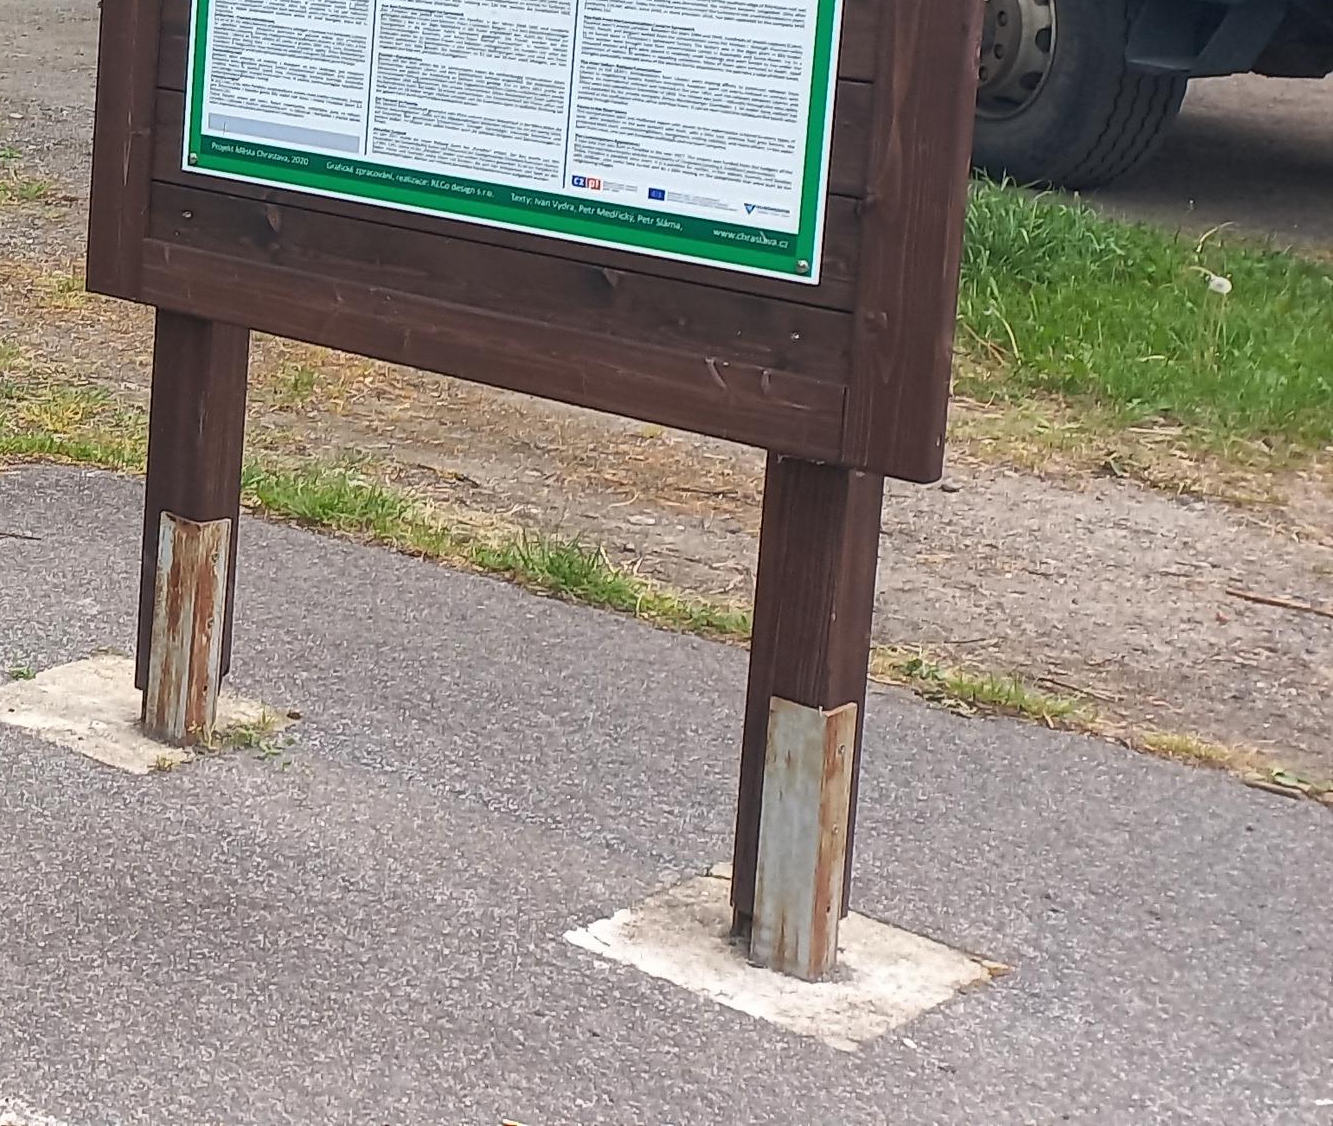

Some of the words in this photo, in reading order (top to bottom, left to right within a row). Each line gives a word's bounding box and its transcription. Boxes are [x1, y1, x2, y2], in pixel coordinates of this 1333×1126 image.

[211, 142, 234, 156] Projekt
[256, 149, 290, 165] Chrastava,
[291, 155, 309, 166] 2020
[355, 165, 395, 181] zpracování,
[451, 183, 475, 195] design
[511, 192, 532, 205] Texty:
[534, 198, 551, 208] Ivan
[552, 200, 577, 214] Vydra,
[579, 204, 596, 216] Petr
[637, 214, 654, 225] Petr
[713, 228, 789, 249] www.chrastava.cz
